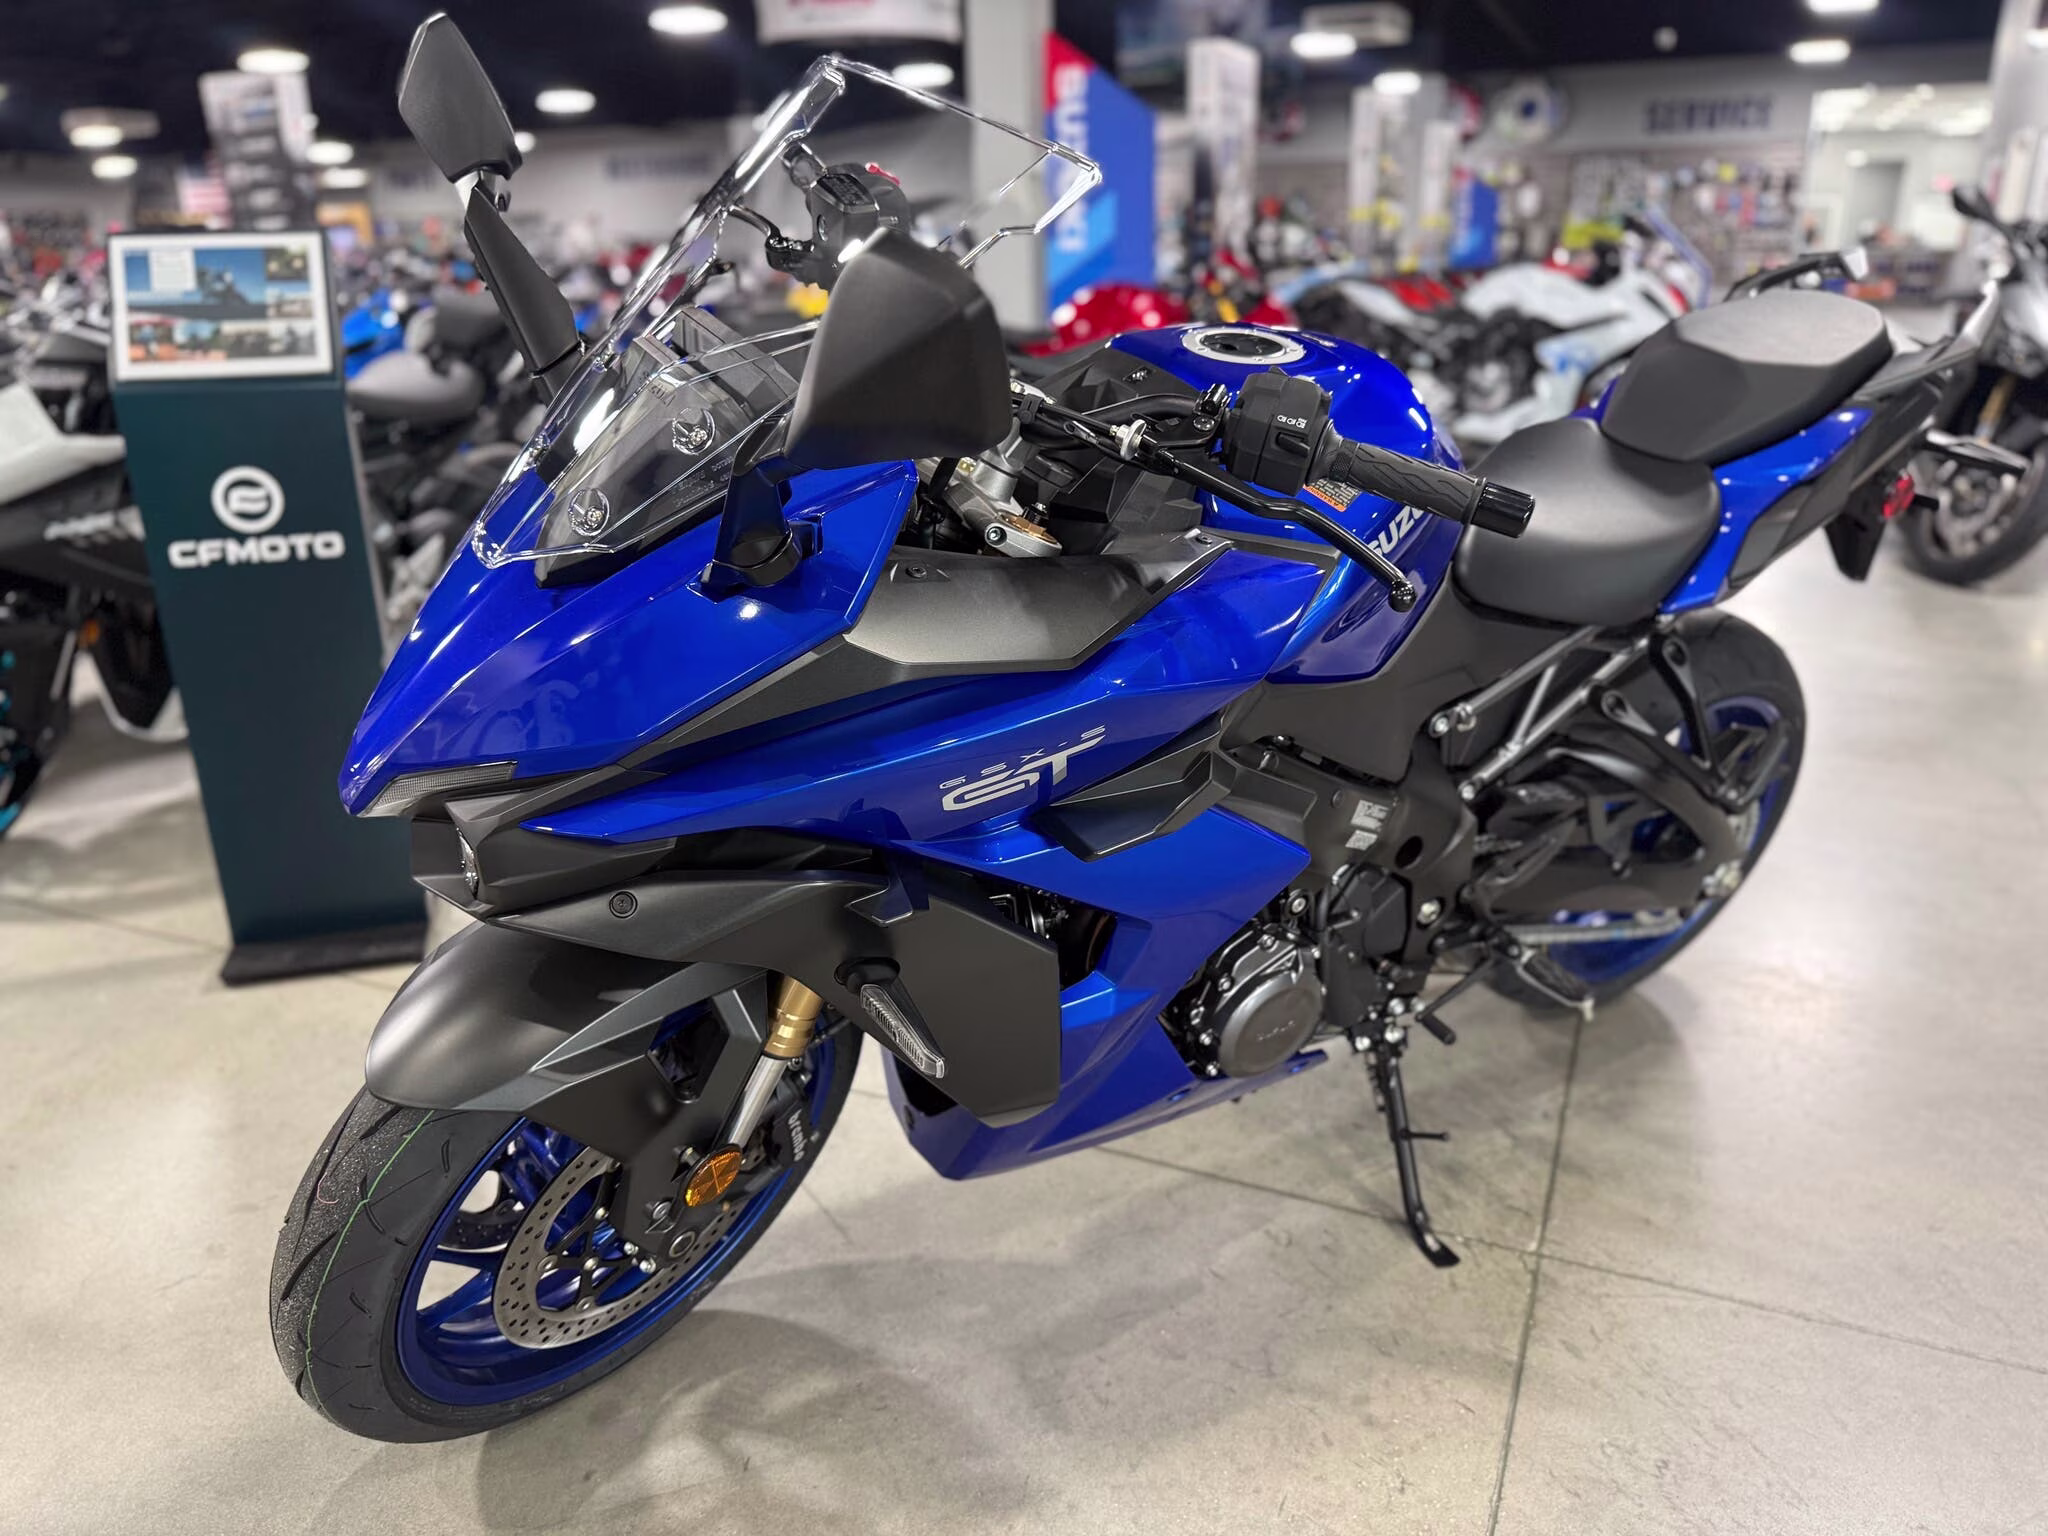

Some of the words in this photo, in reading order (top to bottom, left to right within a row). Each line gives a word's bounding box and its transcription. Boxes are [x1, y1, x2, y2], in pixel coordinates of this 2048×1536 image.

[1648, 97, 1772, 131] SERVICE
[167, 531, 346, 568] CFMOTO
[939, 725, 1106, 789] GSX-S
[942, 734, 1106, 811] GT
[788, 1109, 807, 1162] brembo
